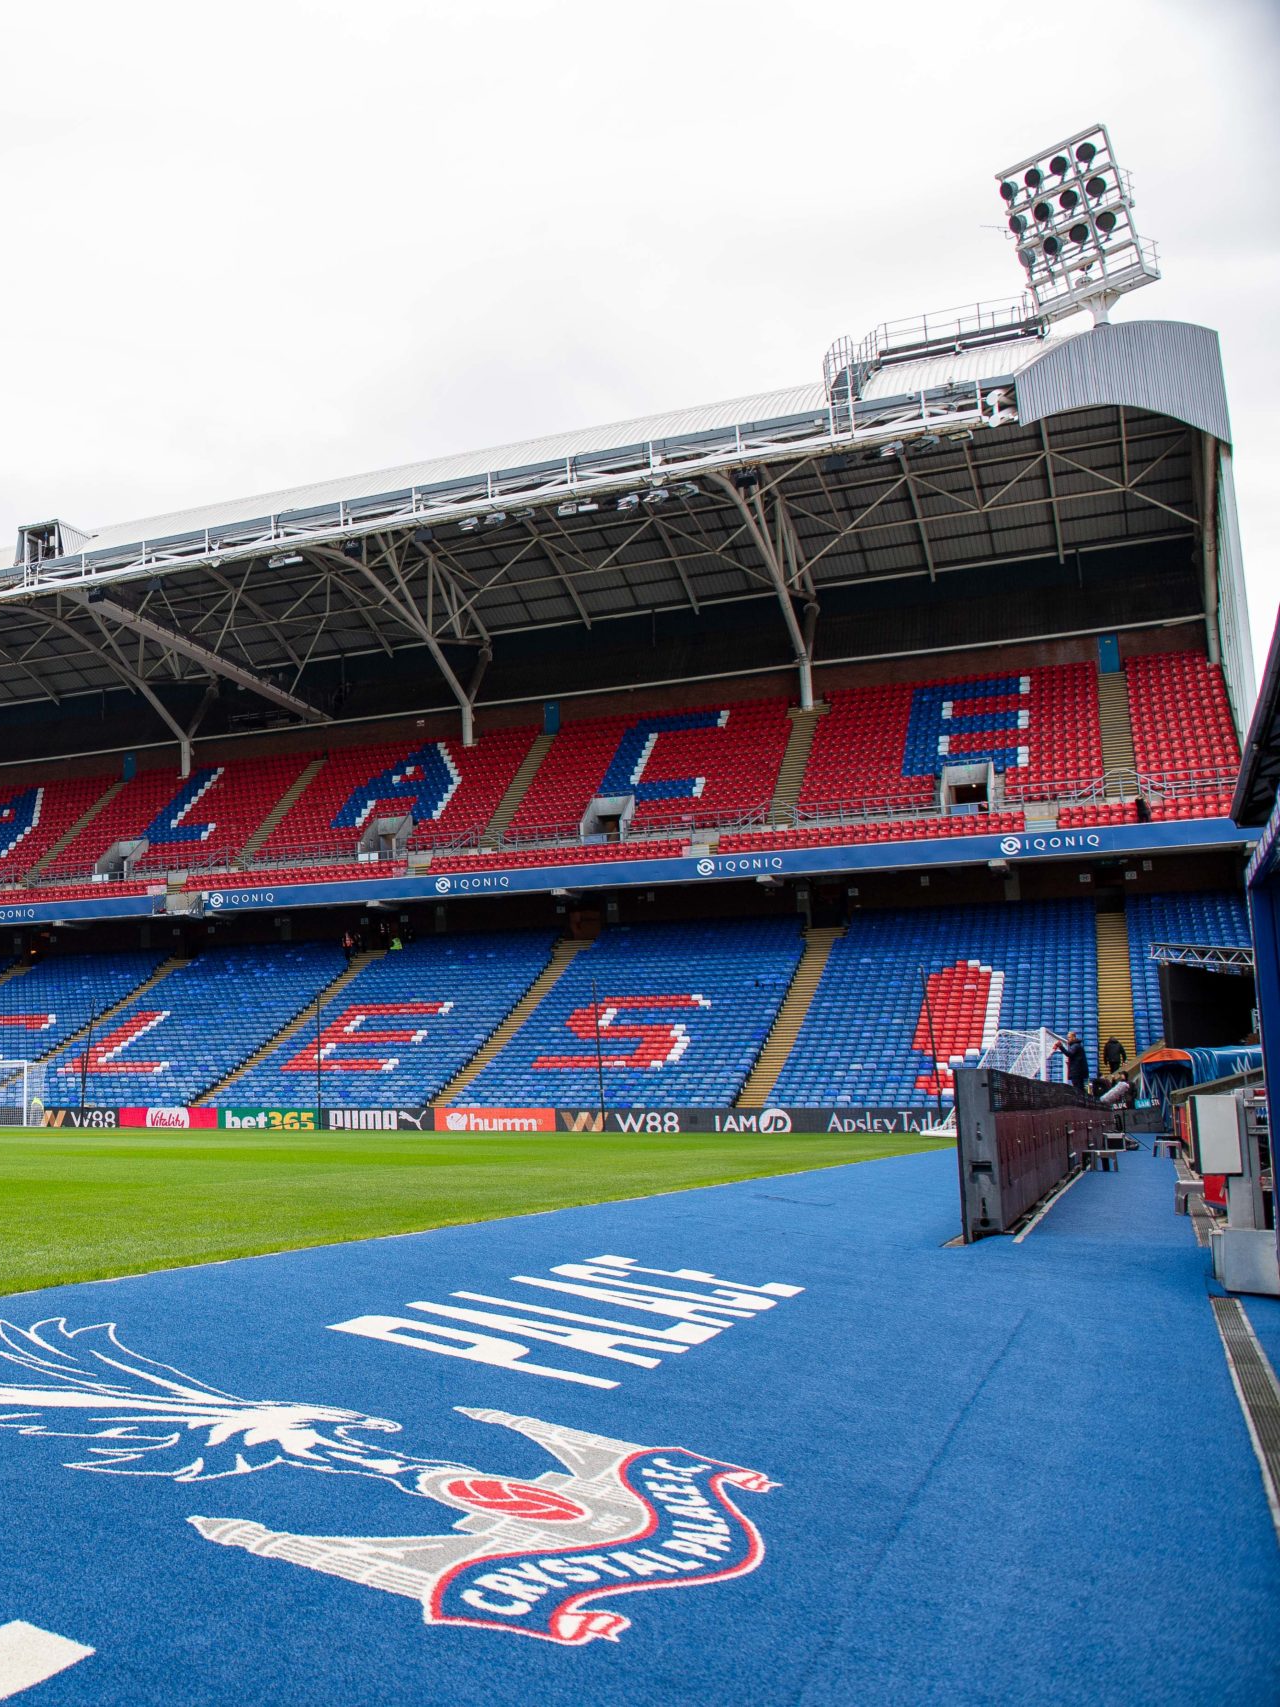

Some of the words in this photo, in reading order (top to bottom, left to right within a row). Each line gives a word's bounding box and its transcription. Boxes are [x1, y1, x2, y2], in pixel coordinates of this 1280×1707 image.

[1023, 832, 1100, 849] IQONIQ
[718, 855, 783, 870] IQONIQ
[453, 875, 510, 889] IQONIQ
[225, 891, 274, 903] IQONIQ
[70, 1110, 116, 1127] W88
[150, 1111, 184, 1127] Vitality
[225, 1110, 315, 1129] bet365
[329, 1110, 398, 1130] PUMA
[469, 1113, 538, 1131] humm
[615, 1112, 680, 1132] W88
[325, 1254, 806, 1389] PALACE
[460, 1549, 705, 1616] CRYSTAL
[644, 1480, 732, 1563] PALACE
